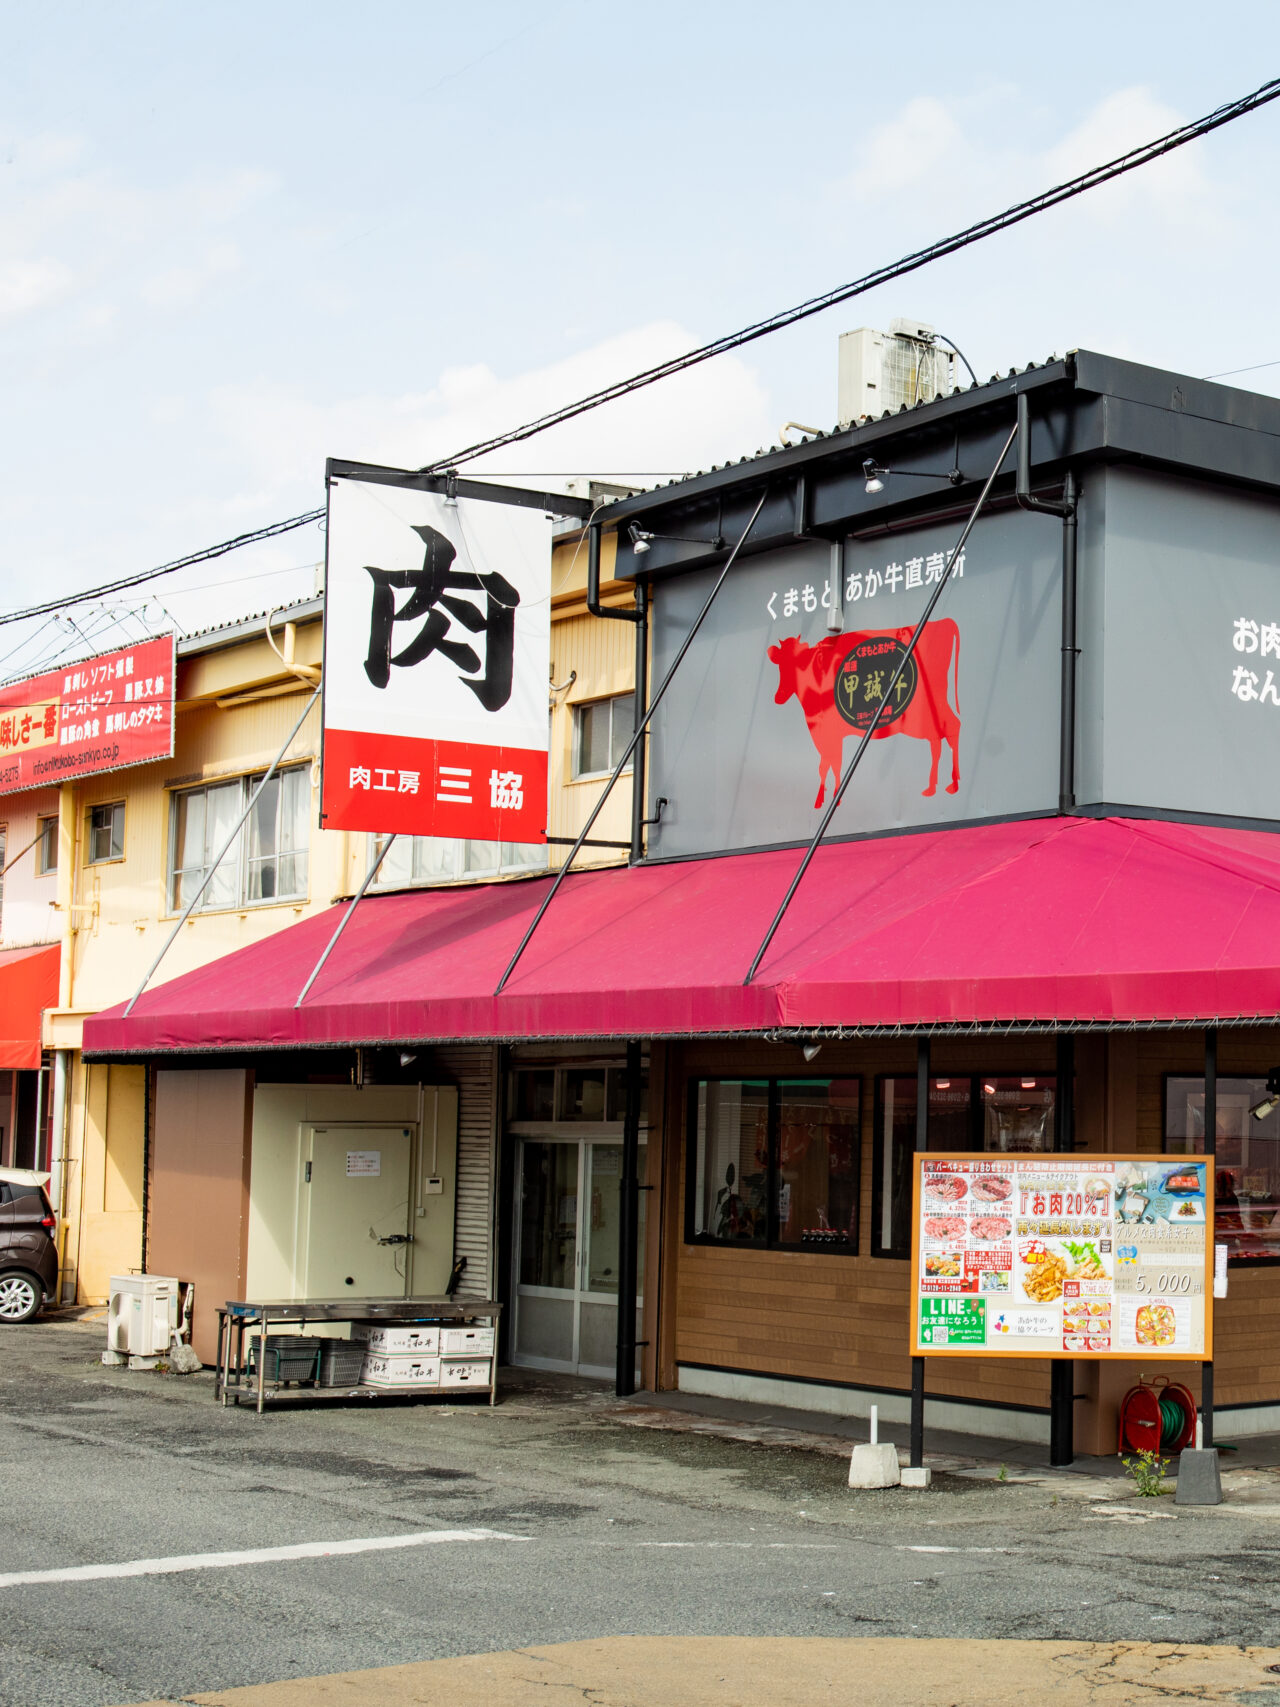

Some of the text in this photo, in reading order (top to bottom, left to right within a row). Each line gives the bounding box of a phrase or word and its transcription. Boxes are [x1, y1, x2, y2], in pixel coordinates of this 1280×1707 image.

[362, 525, 520, 712] 肉
[856, 641, 896, 657] くまもとあか牛
[62, 690, 113, 720] ローストビーフ
[105, 704, 163, 734] 馬刺しのタタキ
[349, 765, 524, 810] 肉工房 三協
